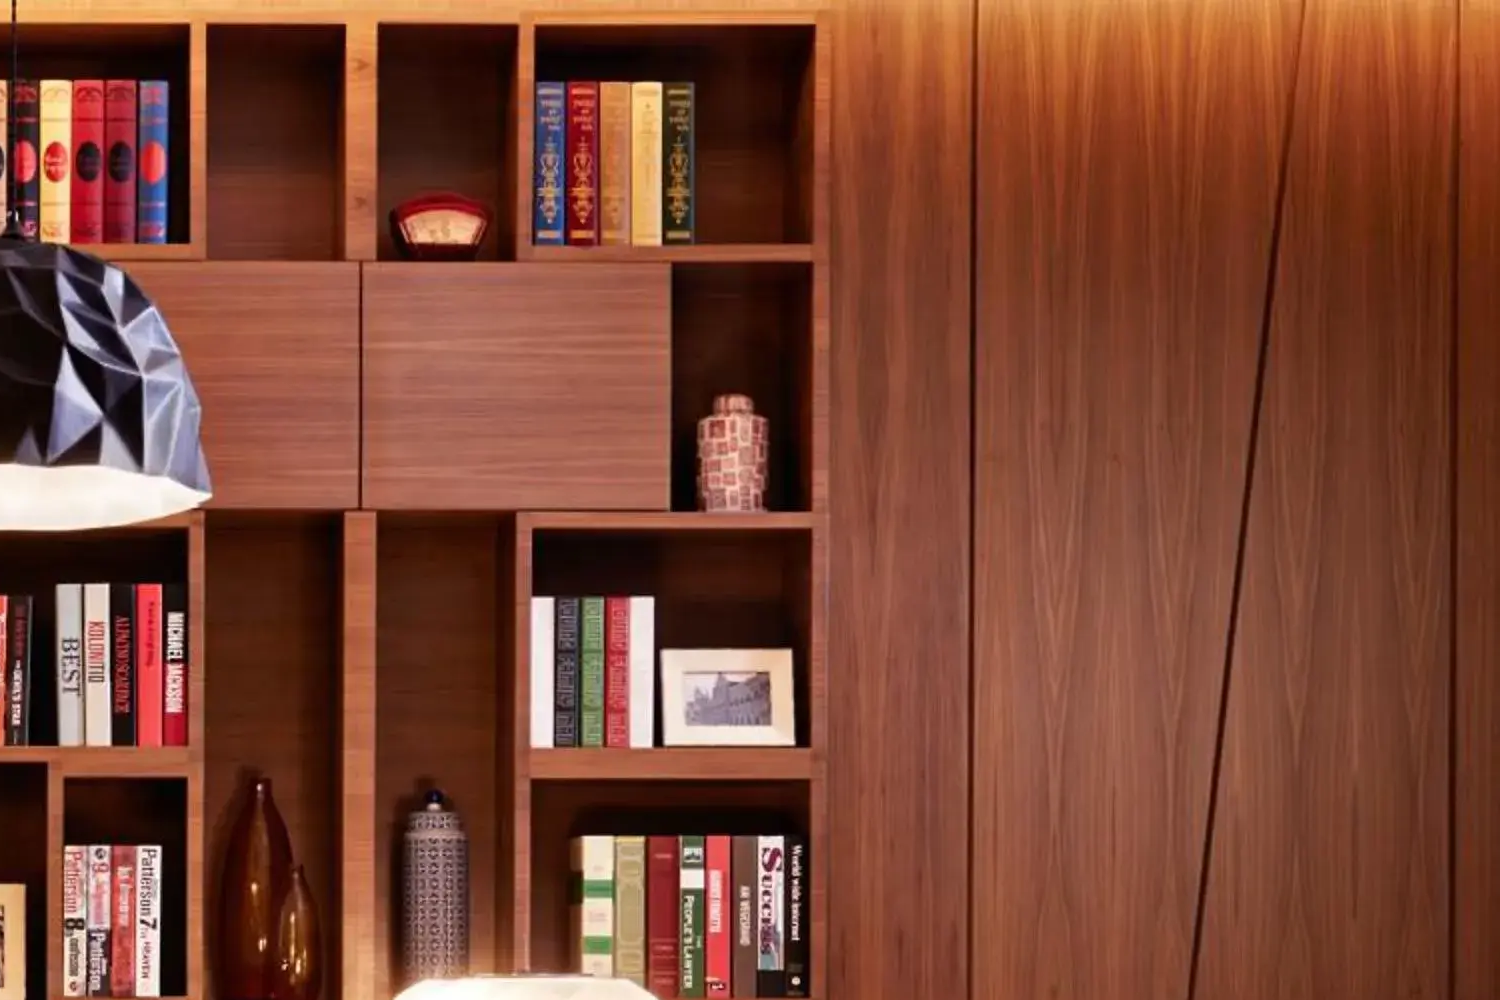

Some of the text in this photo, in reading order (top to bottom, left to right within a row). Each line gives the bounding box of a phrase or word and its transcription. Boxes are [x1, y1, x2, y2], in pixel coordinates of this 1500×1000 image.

[61, 638, 81, 698] BEST
[166, 612, 184, 713] MICHAEL JACKSON
[66, 851, 84, 913] Patterson
[140, 848, 158, 916] Patterson
[90, 933, 106, 990] Patterson
